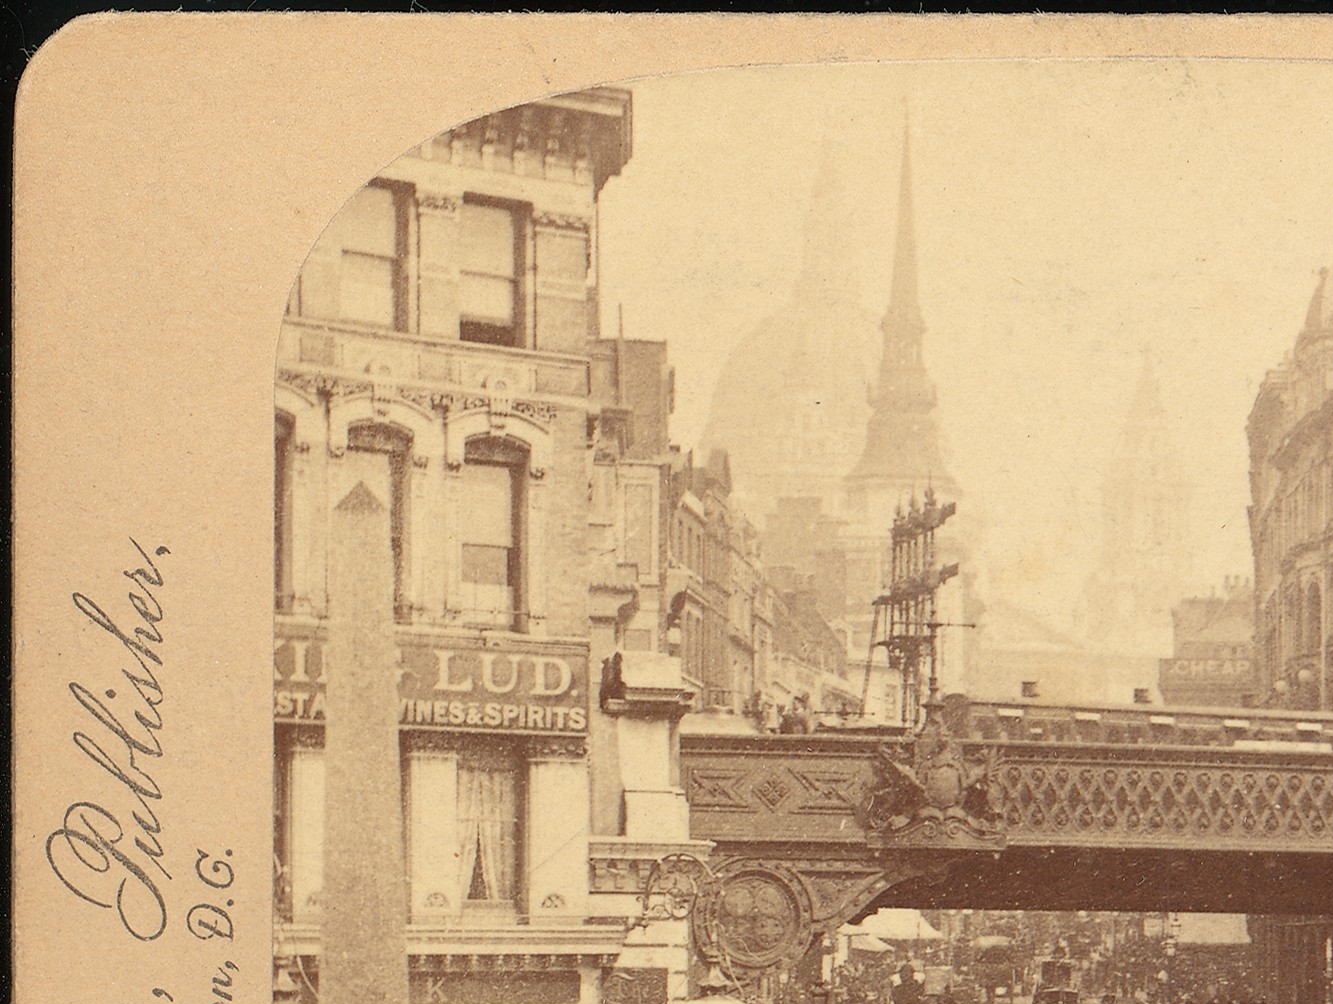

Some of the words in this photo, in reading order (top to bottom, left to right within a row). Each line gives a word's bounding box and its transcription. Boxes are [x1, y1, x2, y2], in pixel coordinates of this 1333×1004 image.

[434, 649, 579, 698] LUD.
[1174, 659, 1250, 676] CHEAP
[44, 536, 172, 943] Publisher,
